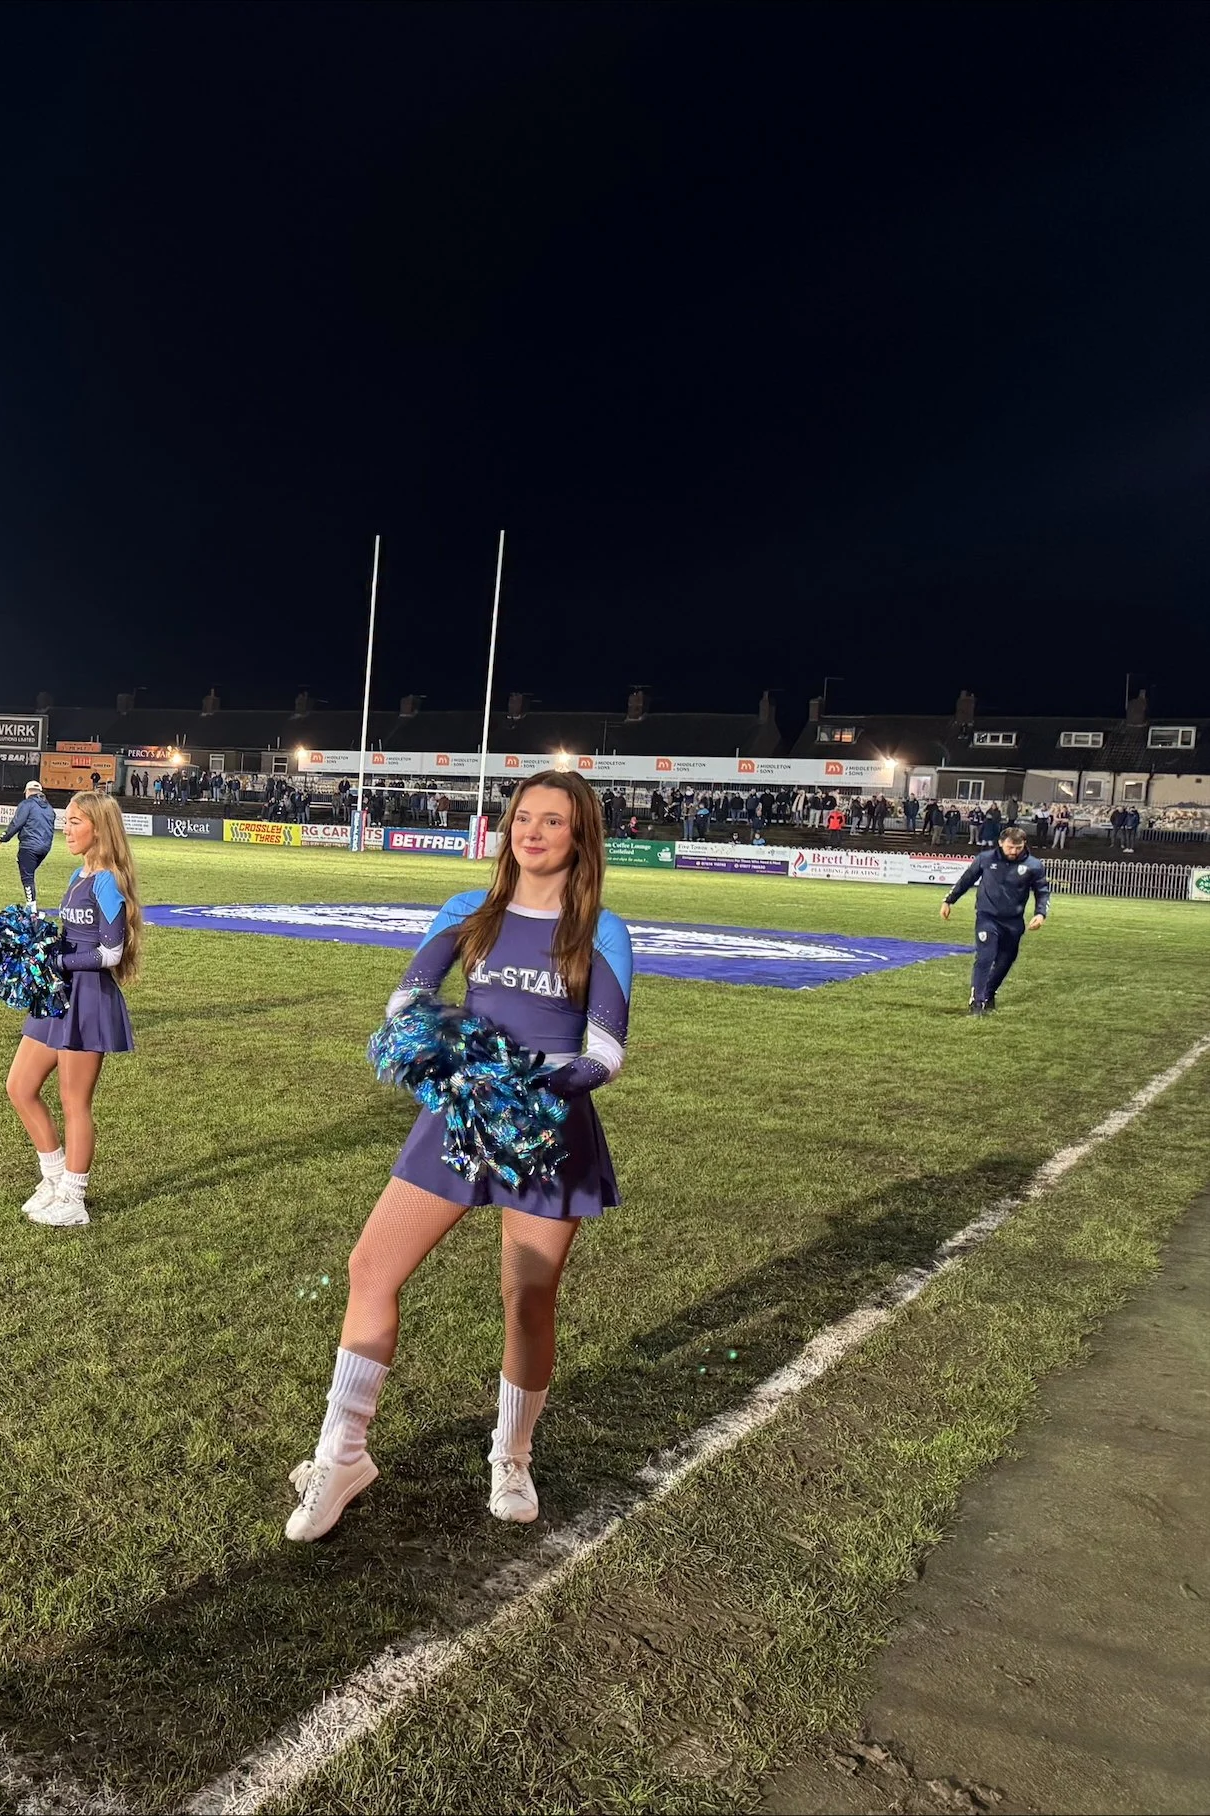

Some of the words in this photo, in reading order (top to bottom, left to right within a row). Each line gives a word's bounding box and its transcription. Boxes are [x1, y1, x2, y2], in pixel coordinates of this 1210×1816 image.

[9, 754, 26, 762] BAR
[128, 749, 155, 758] PERCY'S
[239, 822, 283, 834] CROSSLEY
[301, 826, 318, 836] RG
[322, 826, 383, 840] CARTS
[255, 833, 281, 843] TYRES
[392, 833, 466, 851] BETFRED
[812, 853, 843, 864] Brett
[850, 854, 880, 866] Tuffs
[851, 869, 880, 877] HEATING
[469, 959, 568, 999] L-STAR
